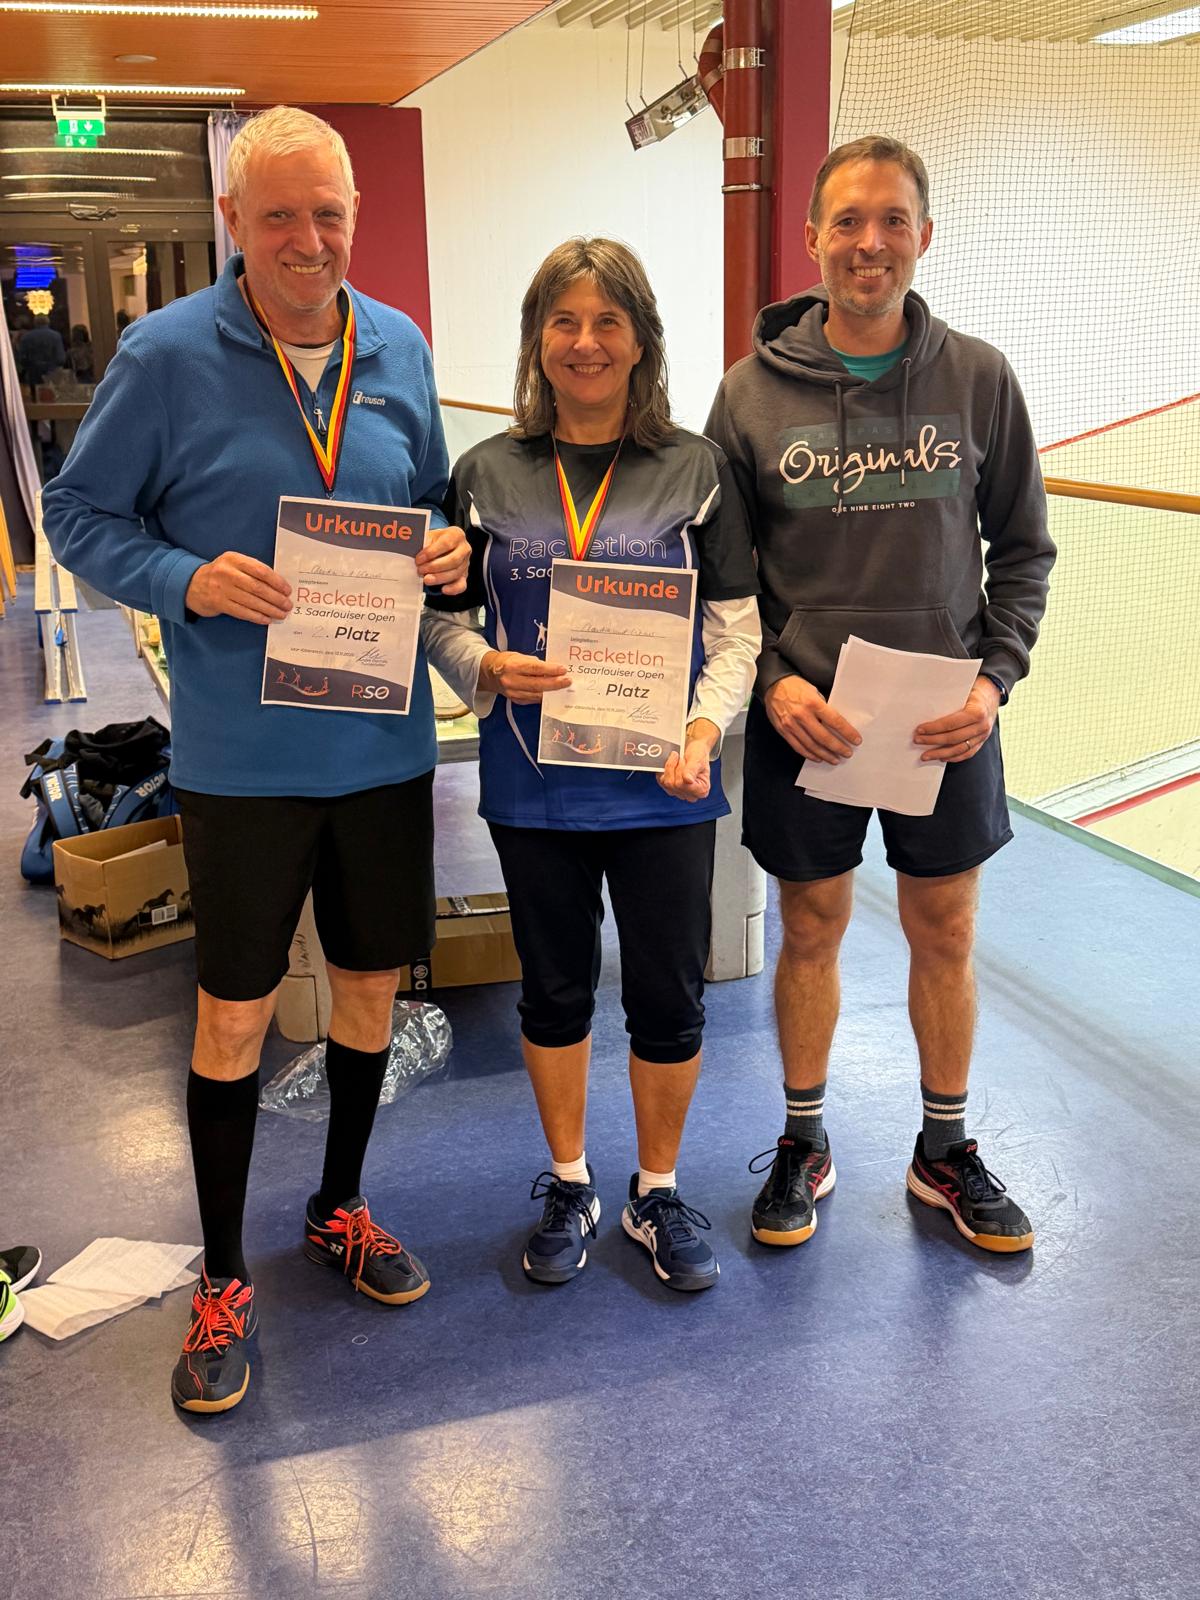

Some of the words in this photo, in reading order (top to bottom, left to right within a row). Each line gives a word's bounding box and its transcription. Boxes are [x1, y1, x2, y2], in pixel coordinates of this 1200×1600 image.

[779, 424, 963, 495] Originals
[872, 503, 895, 511] EIGHT
[898, 501, 916, 509] TWO
[305, 512, 413, 541] Urkunde
[508, 533, 667, 562] Racetlon
[511, 568, 522, 581] 3.
[576, 574, 680, 600] Urkunde
[297, 587, 395, 609] Racketlon
[294, 606, 303, 615] 3.
[305, 607, 366, 620] Saarlouiser
[367, 613, 396, 623] Open
[334, 626, 381, 642] Platz
[569, 645, 664, 667] Racketlon
[567, 664, 575, 673] 3.
[577, 665, 635, 677] Saarlouiser
[636, 670, 665, 680] Open
[606, 683, 651, 699] Platz
